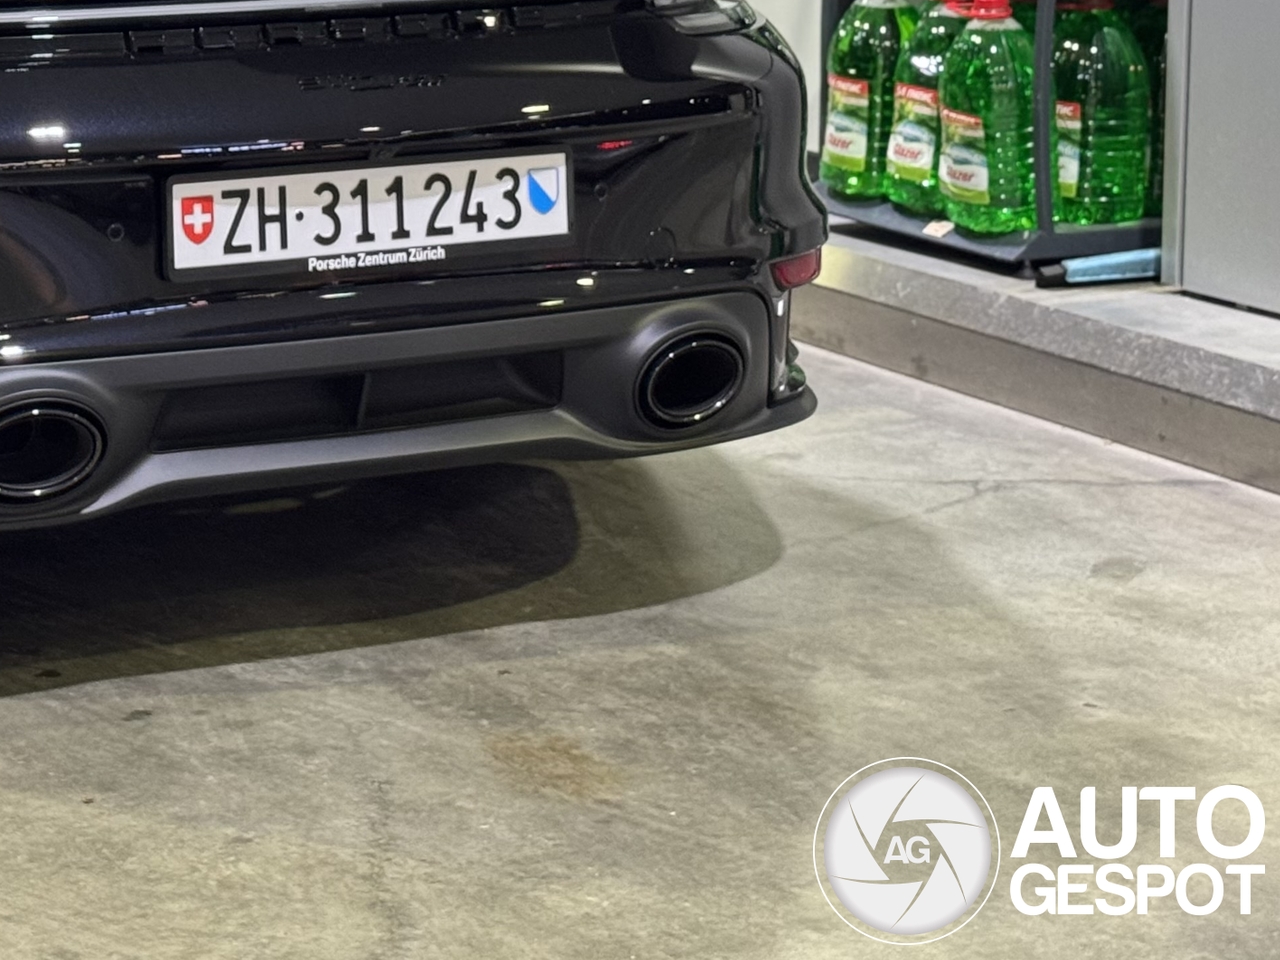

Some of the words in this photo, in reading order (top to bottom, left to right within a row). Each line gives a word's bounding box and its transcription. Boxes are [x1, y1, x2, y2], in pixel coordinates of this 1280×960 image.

[308, 256, 357, 272] Porsche
[357, 250, 407, 268] Zentrum
[408, 246, 446, 263] Zürich
